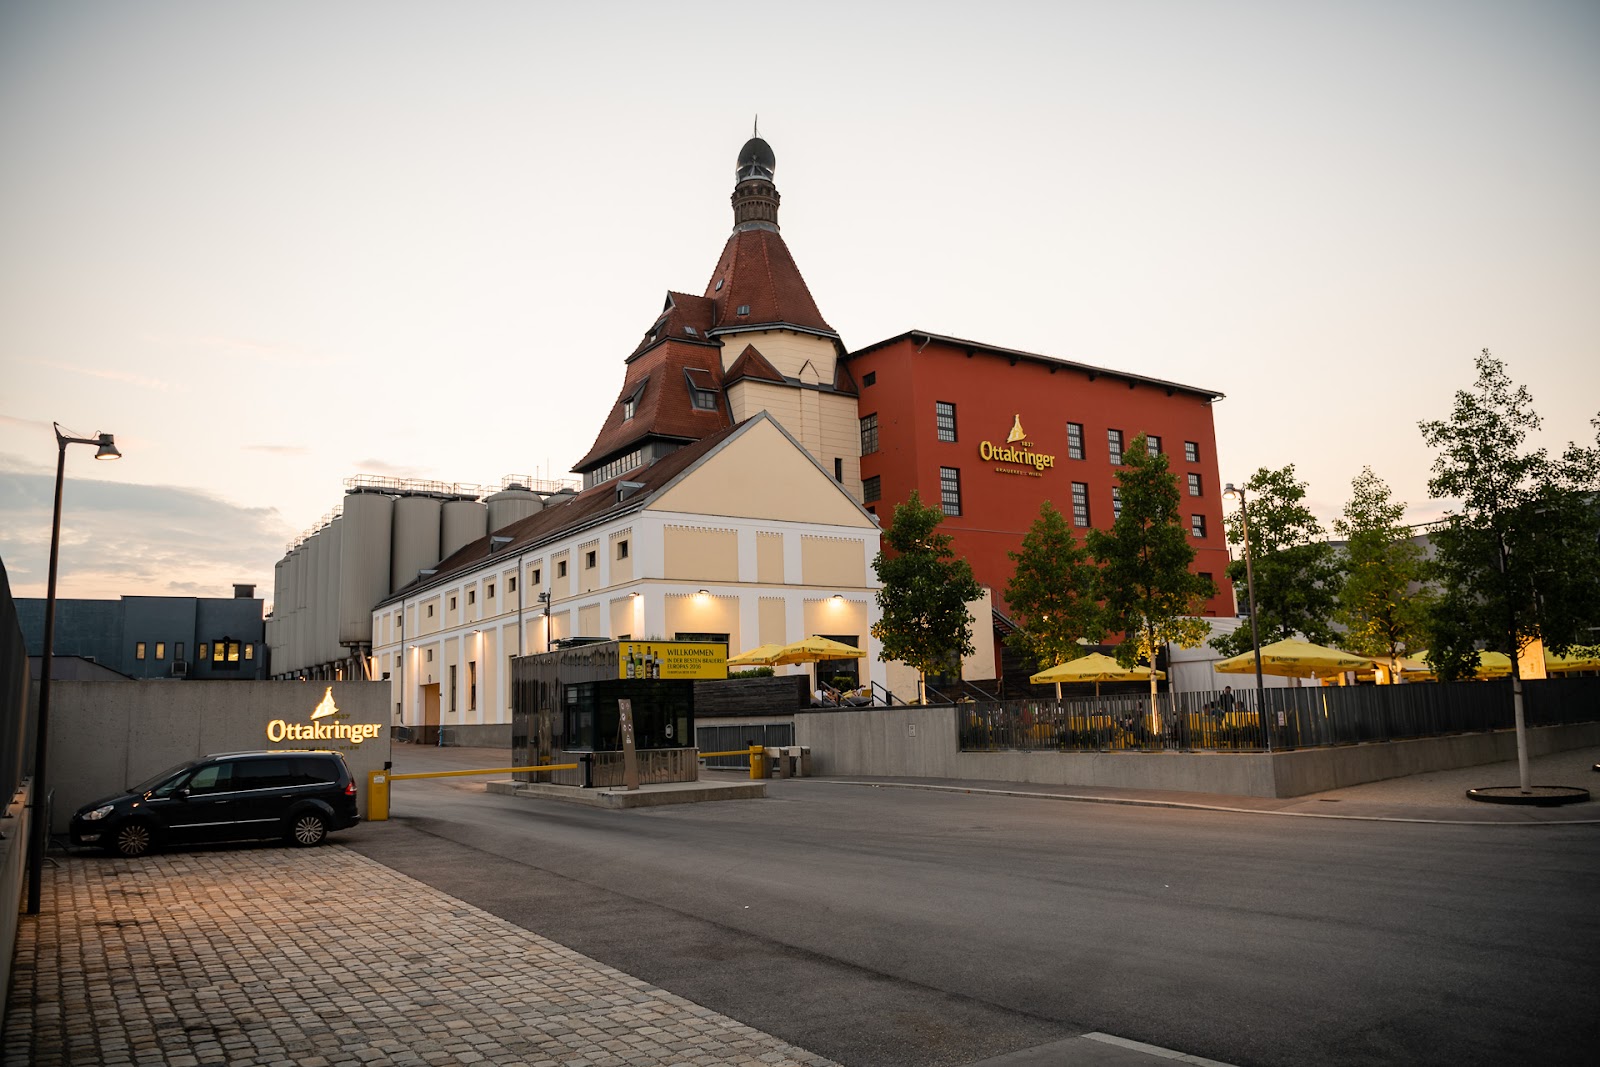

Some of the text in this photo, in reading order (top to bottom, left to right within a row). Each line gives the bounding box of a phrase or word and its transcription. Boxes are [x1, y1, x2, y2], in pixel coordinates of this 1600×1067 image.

[980, 440, 1055, 470] Ottakringer
[995, 467, 1023, 475] BRAUEREI
[267, 719, 382, 743] Ottakringer
